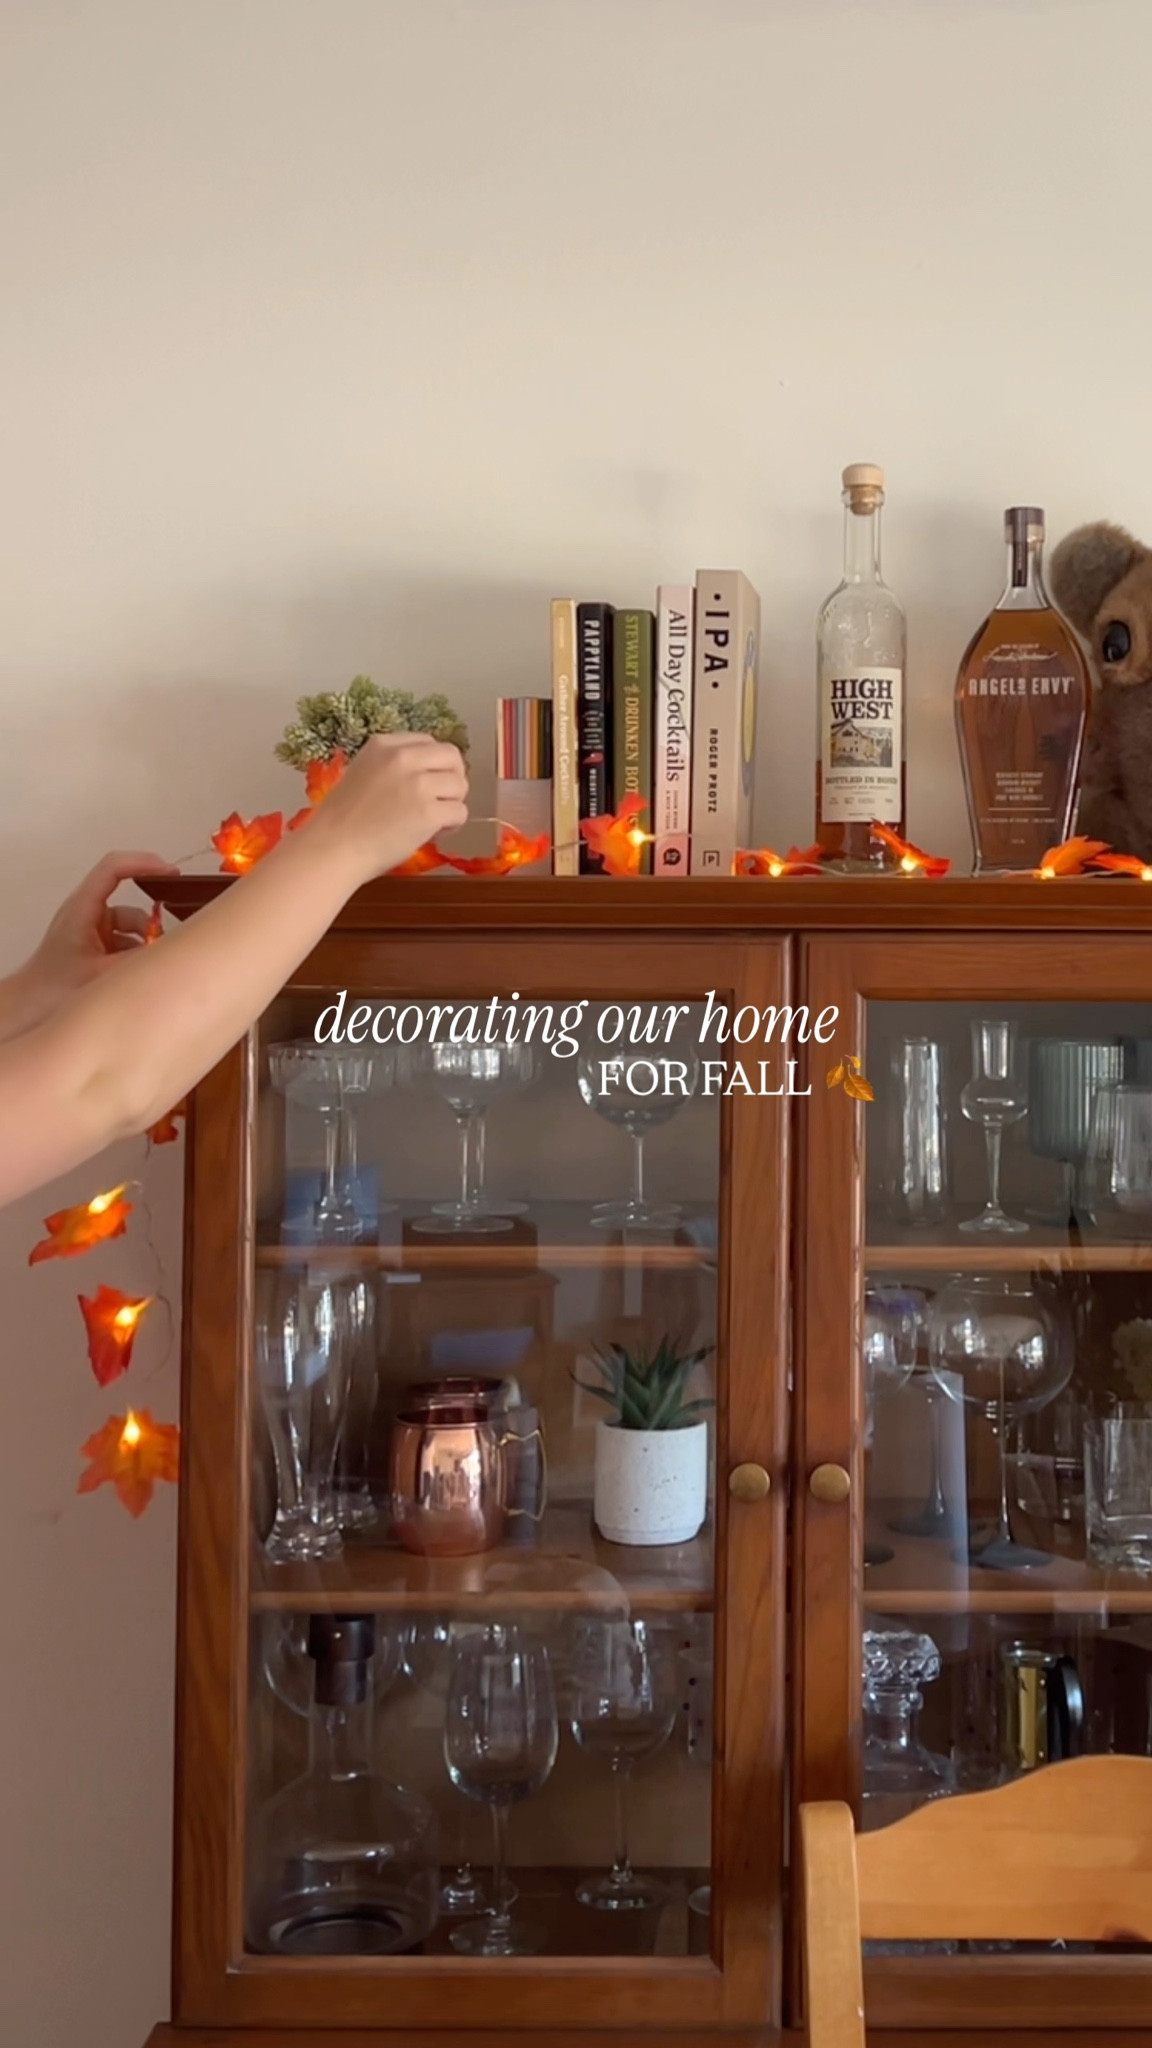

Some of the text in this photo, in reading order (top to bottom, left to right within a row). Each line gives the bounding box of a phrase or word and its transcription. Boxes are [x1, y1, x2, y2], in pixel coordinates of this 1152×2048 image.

[583, 619, 601, 701] PAPPYLAND
[624, 614, 640, 678] STEWART
[664, 609, 688, 782] All Day Cocktails
[831, 678, 893, 699] HIGH
[831, 701, 893, 719] WEST
[1031, 676, 1071, 695] ENVY
[624, 697, 640, 761] DRUNKEN
[707, 727, 718, 814] ROGER PROTZ
